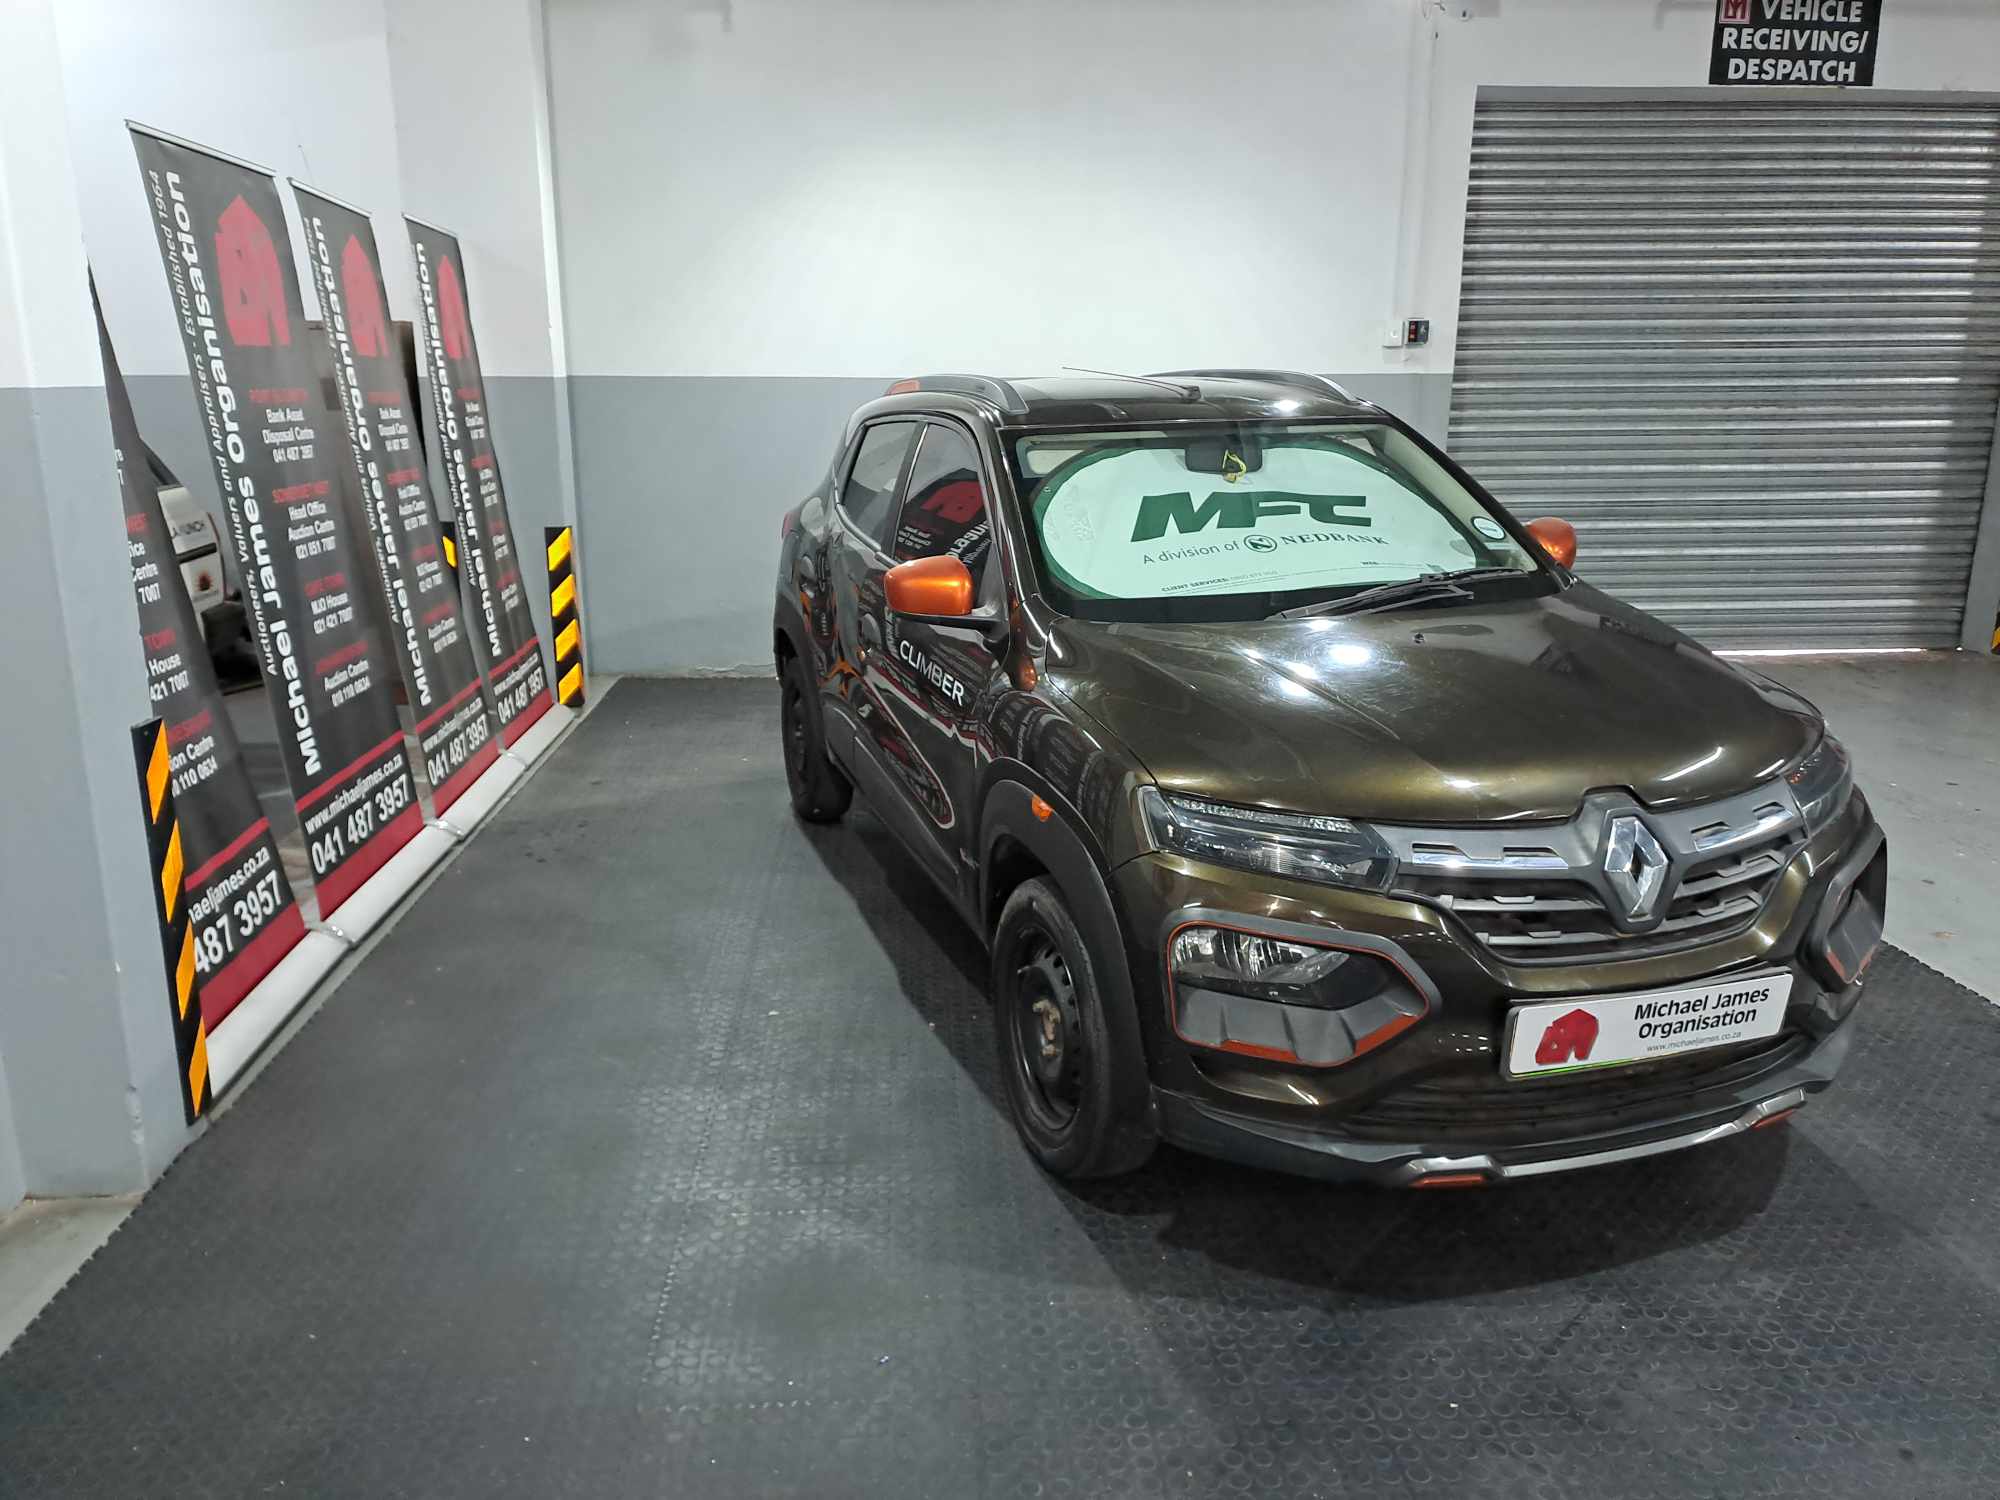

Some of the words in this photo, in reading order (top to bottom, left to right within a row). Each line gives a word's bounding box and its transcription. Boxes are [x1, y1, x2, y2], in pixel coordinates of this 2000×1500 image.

[1722, 27, 1869, 54] RECEIVING/
[1762, 0, 1864, 23] VEHICLE
[1728, 57, 1857, 83] DESPATCH
[149, 170, 168, 219] 1964
[161, 224, 196, 337] Established
[166, 171, 245, 464] Organisation
[312, 217, 372, 451] Organisation
[415, 242, 458, 440] Organisation
[193, 354, 224, 452] Appraisers
[216, 455, 233, 492] and
[228, 497, 250, 563] Valuers
[238, 476, 282, 609] James
[367, 461, 400, 571] James
[1130, 490, 1372, 542] MFC
[1143, 554, 1155, 565] A
[1158, 544, 1221, 562] division
[1224, 540, 1240, 552] of
[1280, 532, 1390, 545] NEDBANK
[471, 548, 502, 657] Michael
[148, 653, 182, 678] House
[392, 578, 432, 707] Michael
[899, 639, 965, 706] CLIMBER
[269, 619, 322, 777] Michael
[497, 696, 516, 725] 041
[427, 748, 450, 786] 041
[449, 734, 467, 766] 487
[465, 713, 489, 750] 3957
[304, 754, 403, 835] www.michaeljames.co.za
[311, 825, 345, 875] 041
[347, 801, 375, 845] 487
[375, 773, 410, 822] 3957
[194, 913, 235, 973] 487
[233, 869, 282, 937] 3957
[1634, 994, 1709, 1021] Michael
[1711, 987, 1770, 1010] James
[1638, 1008, 1757, 1040] Organisation
[1647, 1031, 1742, 1052] www.michaeljames.co.za
